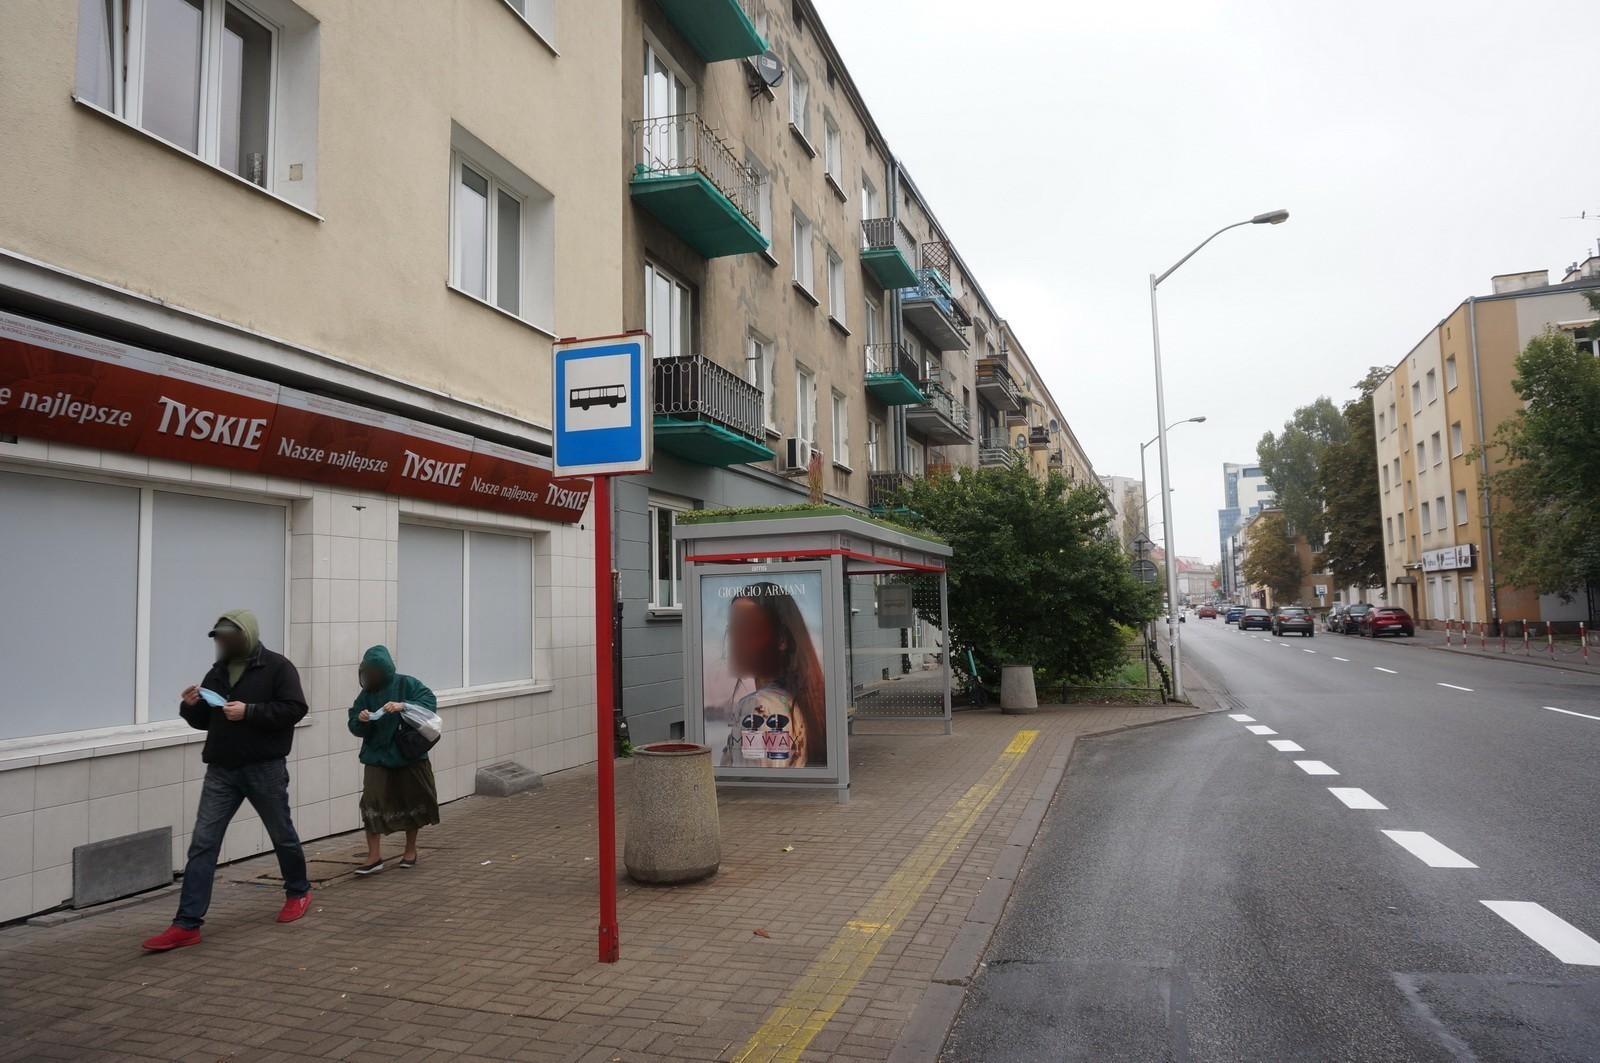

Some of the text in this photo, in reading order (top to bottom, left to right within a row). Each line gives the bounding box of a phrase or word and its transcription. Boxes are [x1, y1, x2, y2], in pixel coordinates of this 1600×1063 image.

[20, 391, 132, 428] najlepsze
[157, 396, 267, 450] TYSKIE
[277, 437, 325, 462] Nasze
[327, 450, 388, 473] najlepsze
[400, 450, 466, 487] TYSKIE
[470, 476, 499, 496] Nasze
[500, 484, 538, 503] najlepsze
[544, 482, 589, 511] TYSKIE
[718, 583, 806, 598] GIORGIO ARMANI
[731, 735, 799, 747] MY WAY
